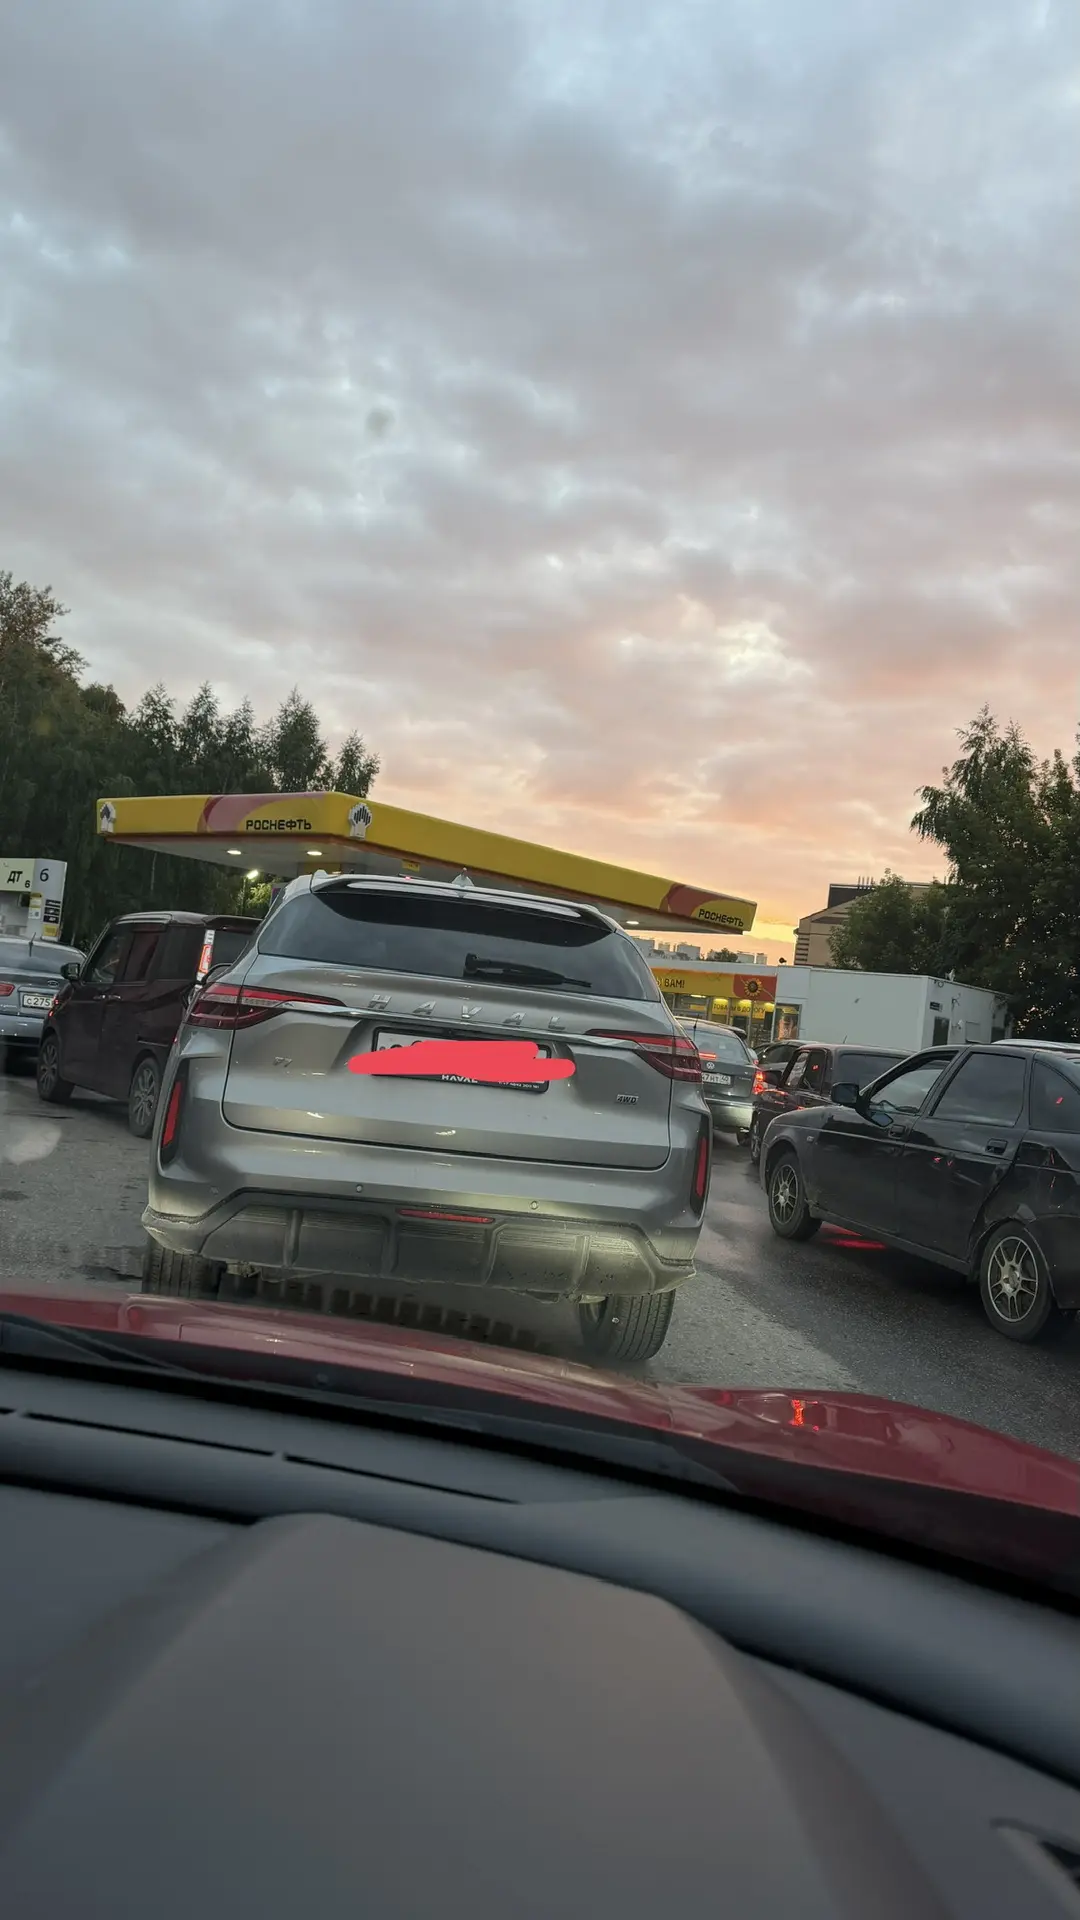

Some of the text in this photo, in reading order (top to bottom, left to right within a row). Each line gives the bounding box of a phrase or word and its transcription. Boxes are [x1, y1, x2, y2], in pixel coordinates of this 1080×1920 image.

[245, 818, 312, 831] РОСНЕФТЬ
[7, 870, 23, 883] ДТ
[40, 868, 50, 882] 6
[24, 880, 31, 889] 6
[698, 908, 744, 927] РОСНЕФТЬ
[664, 978, 685, 989] ВАМ!
[367, 993, 566, 1031] HAVAL
[441, 1074, 478, 1084] HAVAL
[617, 1095, 637, 1104] 4WD
